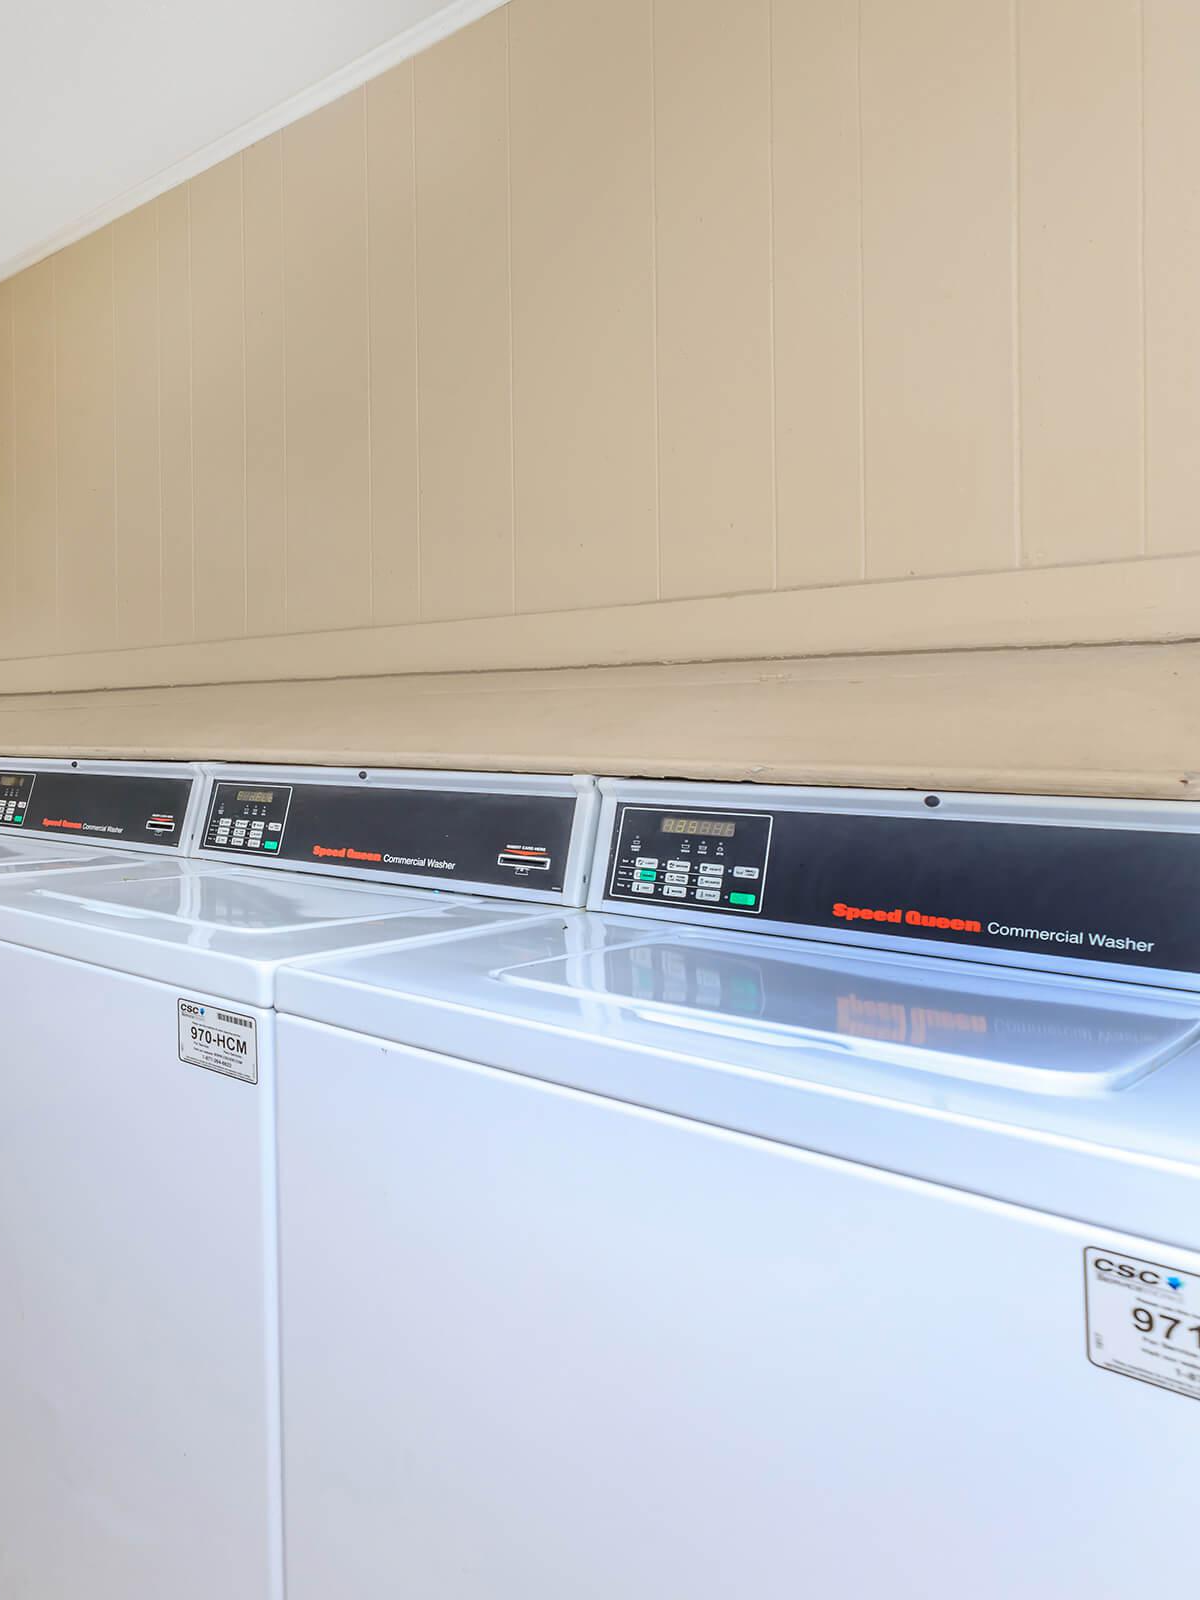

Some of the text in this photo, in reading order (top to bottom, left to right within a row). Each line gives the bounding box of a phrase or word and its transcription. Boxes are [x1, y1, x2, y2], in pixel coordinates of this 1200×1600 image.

[312, 845, 456, 870] Speed Queen Commercial Washer
[832, 902, 1155, 953] Speed Queen Commercial Washer
[180, 1003, 199, 1015] CSC
[190, 1026, 247, 1055] 970-HCM
[1094, 1258, 1160, 1285] CSC
